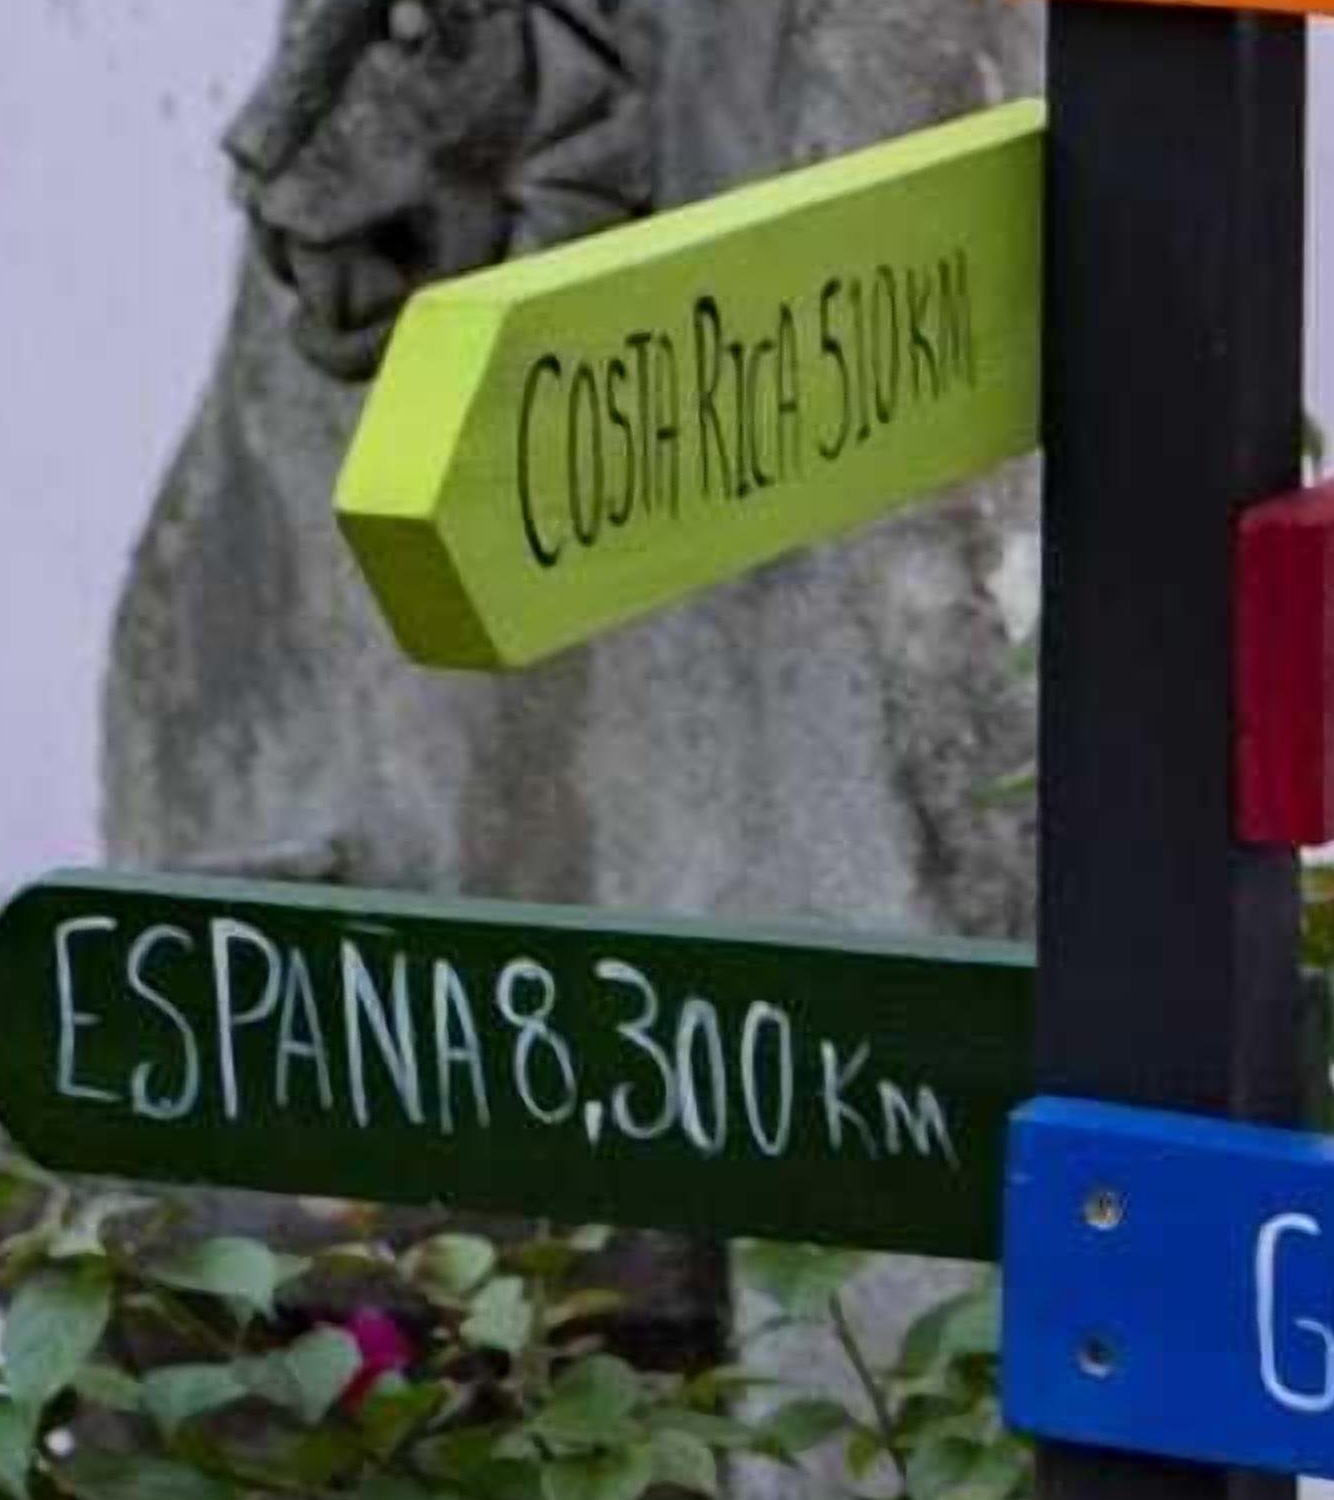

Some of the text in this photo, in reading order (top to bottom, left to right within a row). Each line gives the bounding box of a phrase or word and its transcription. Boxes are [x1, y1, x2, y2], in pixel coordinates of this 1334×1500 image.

[517, 326, 680, 568] COSTA
[692, 294, 805, 502] RICA
[53, 916, 491, 1136] ESPAÑA
[495, 956, 795, 1158] 8,300
